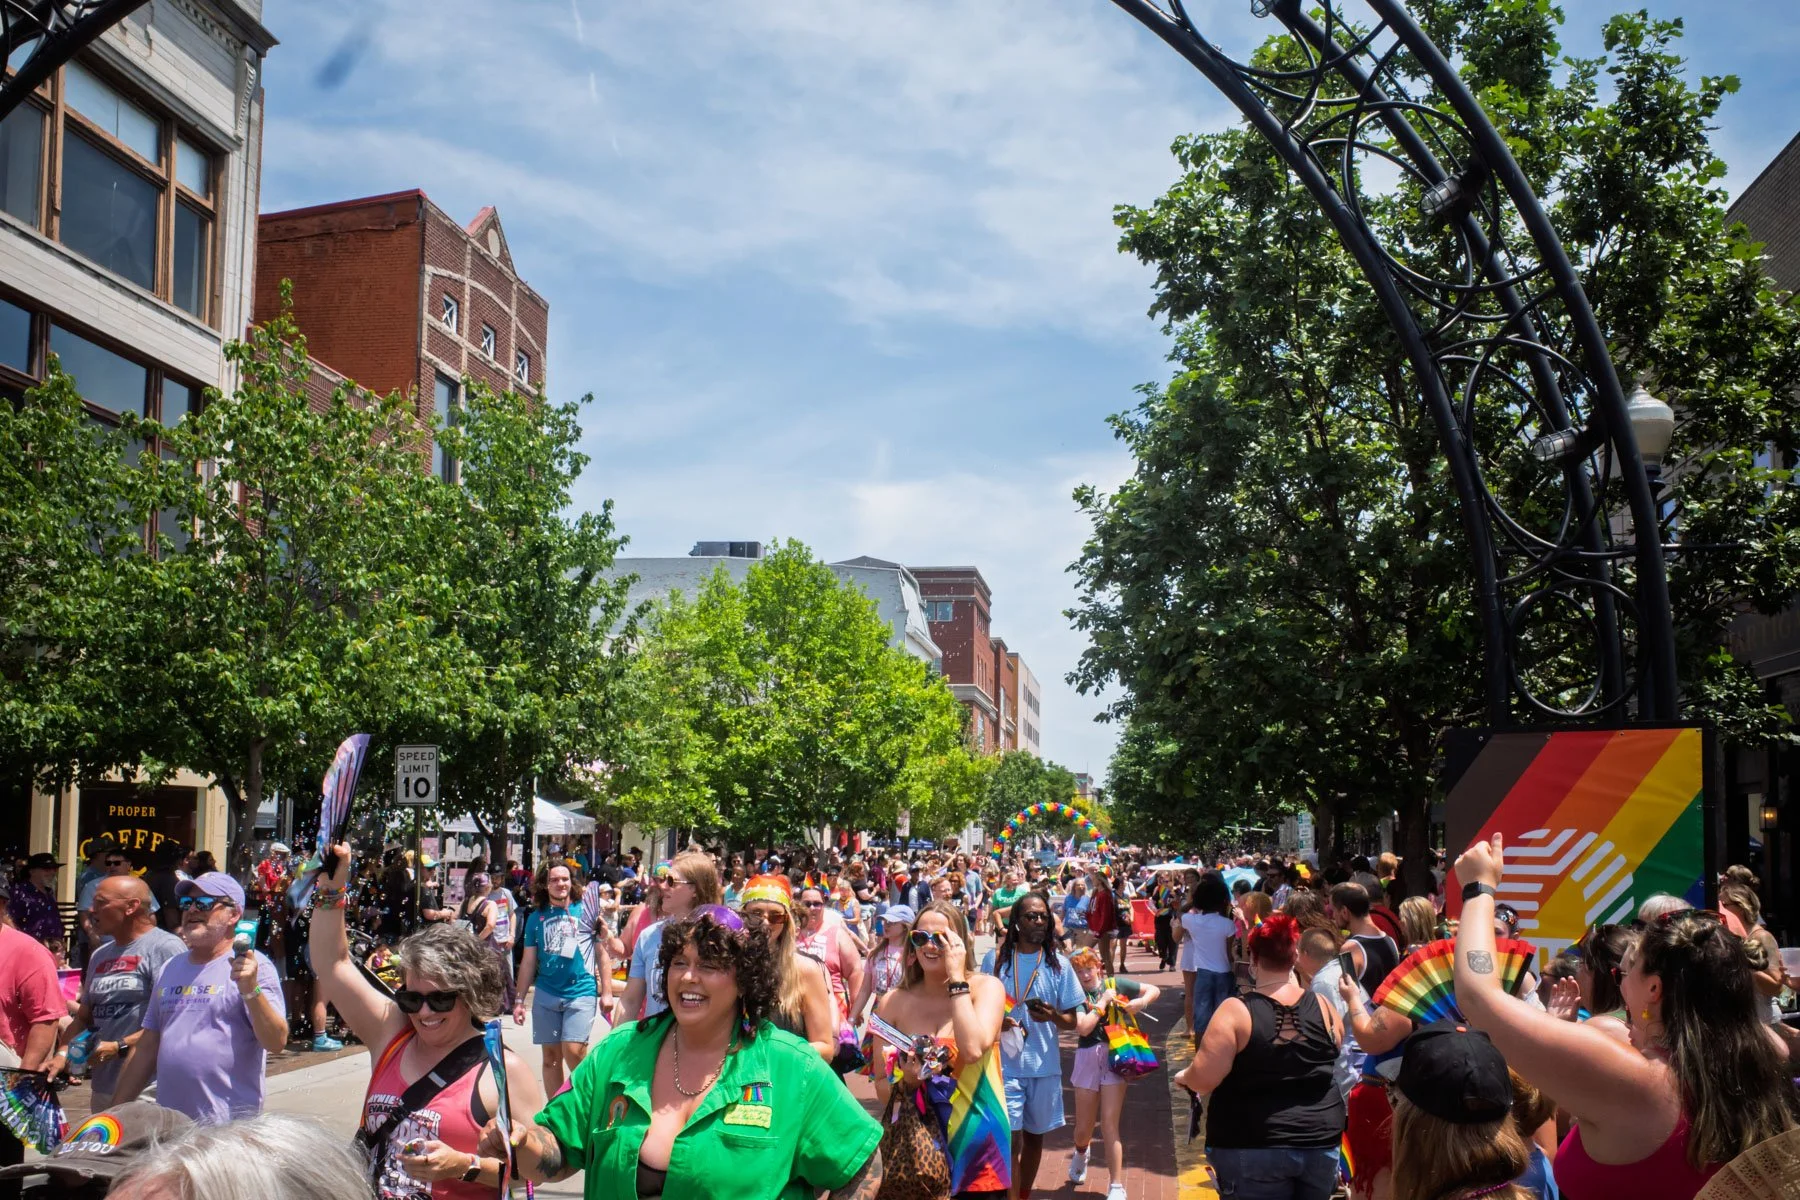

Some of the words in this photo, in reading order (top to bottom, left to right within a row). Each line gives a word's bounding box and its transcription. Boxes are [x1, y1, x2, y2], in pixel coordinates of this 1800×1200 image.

[399, 751, 436, 761] SPEED
[402, 764, 431, 773] LIMIT
[403, 776, 431, 799] 10
[108, 804, 157, 817] PROPER
[79, 828, 181, 861] CFFE
[104, 960, 128, 972] RED
[92, 978, 130, 992] WHITE
[170, 984, 225, 996] YOURSELF
[58, 1141, 80, 1154] BE
[78, 1141, 115, 1154] YOU
